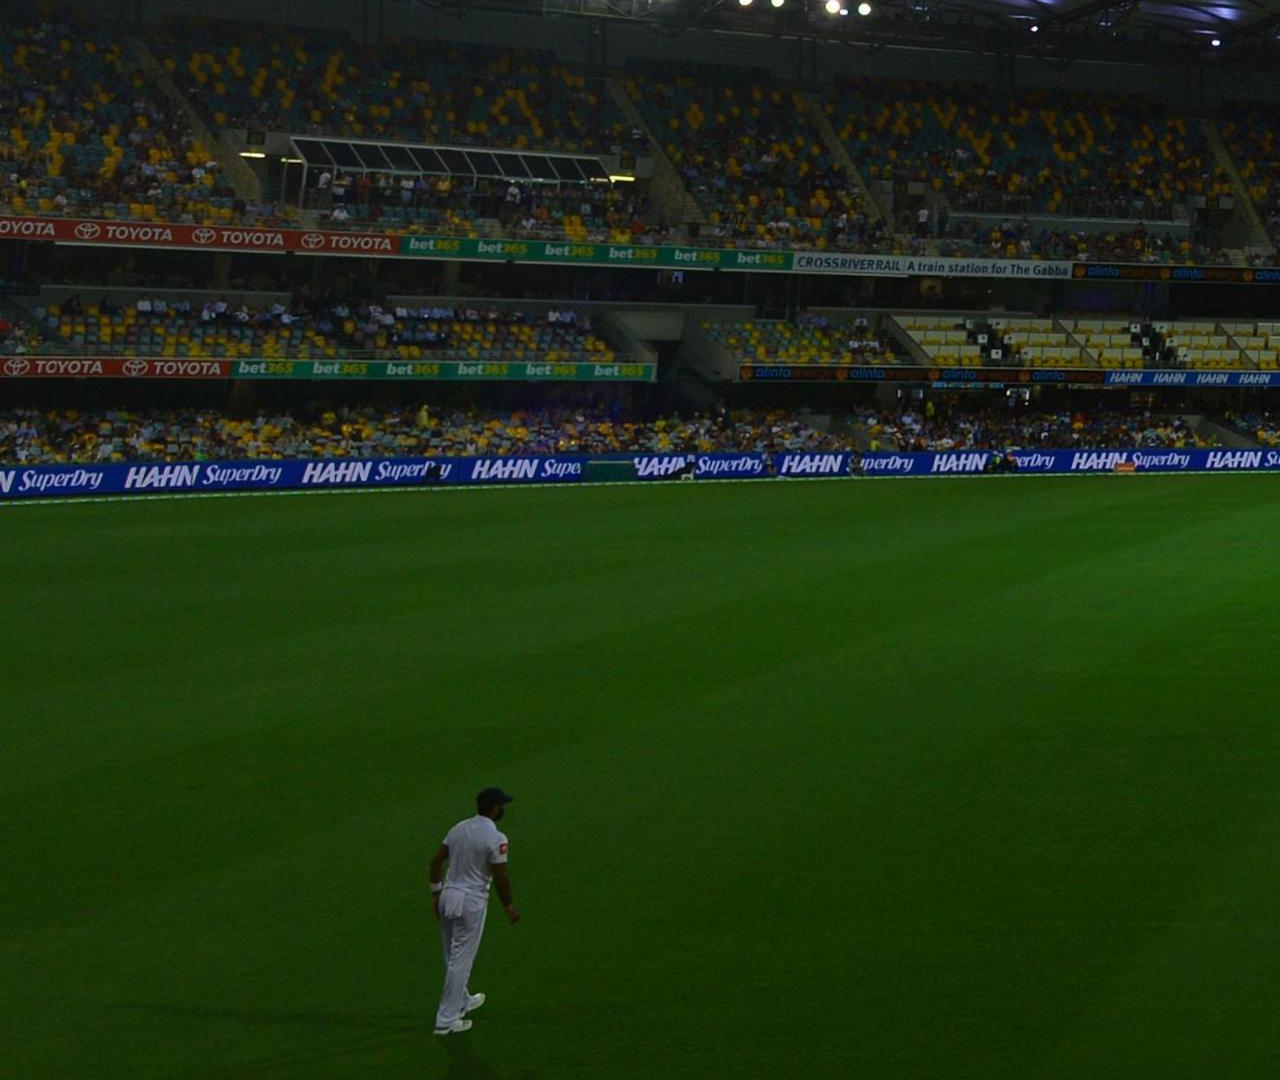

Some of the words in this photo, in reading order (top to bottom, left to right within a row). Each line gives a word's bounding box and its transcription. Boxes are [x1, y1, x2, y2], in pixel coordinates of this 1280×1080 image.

[0, 221, 55, 237] OYOTA
[106, 225, 173, 242] TOYOTA
[222, 231, 284, 247] TOYOTA
[330, 236, 392, 251] TOYOTA
[409, 237, 461, 252] bet365
[478, 241, 528, 256] bet365
[907, 261, 914, 271] A
[917, 261, 945, 273] train
[949, 263, 988, 276] station
[991, 265, 1006, 276] for
[1010, 265, 1030, 277] The
[1034, 266, 1068, 278] Gabba
[35, 360, 103, 375] TOYOTA
[154, 361, 221, 376] TOYOTA
[239, 361, 293, 375] bet365
[313, 362, 368, 376] bet365
[387, 362, 439, 376] bet365
[458, 363, 508, 376] bet365
[526, 363, 577, 377] bet365
[594, 364, 644, 377] bet365
[1111, 372, 1142, 383] HAHN
[1153, 372, 1186, 384] HAHN
[1197, 372, 1229, 384] HAHN
[1239, 373, 1271, 384] HAHN
[18, 469, 103, 492] SuperDry
[124, 465, 200, 489] HAHN
[202, 464, 282, 488] SuperDry
[301, 461, 371, 484] HAHN
[375, 460, 452, 482] SuperDy
[471, 459, 539, 480] HAHN
[541, 459, 582, 478] Supe
[781, 454, 842, 474] HAHN
[846, 453, 914, 475] uperDry
[931, 453, 987, 472] HAHN
[1132, 452, 1190, 470] SuperDry
[1206, 451, 1262, 470] HAHN
